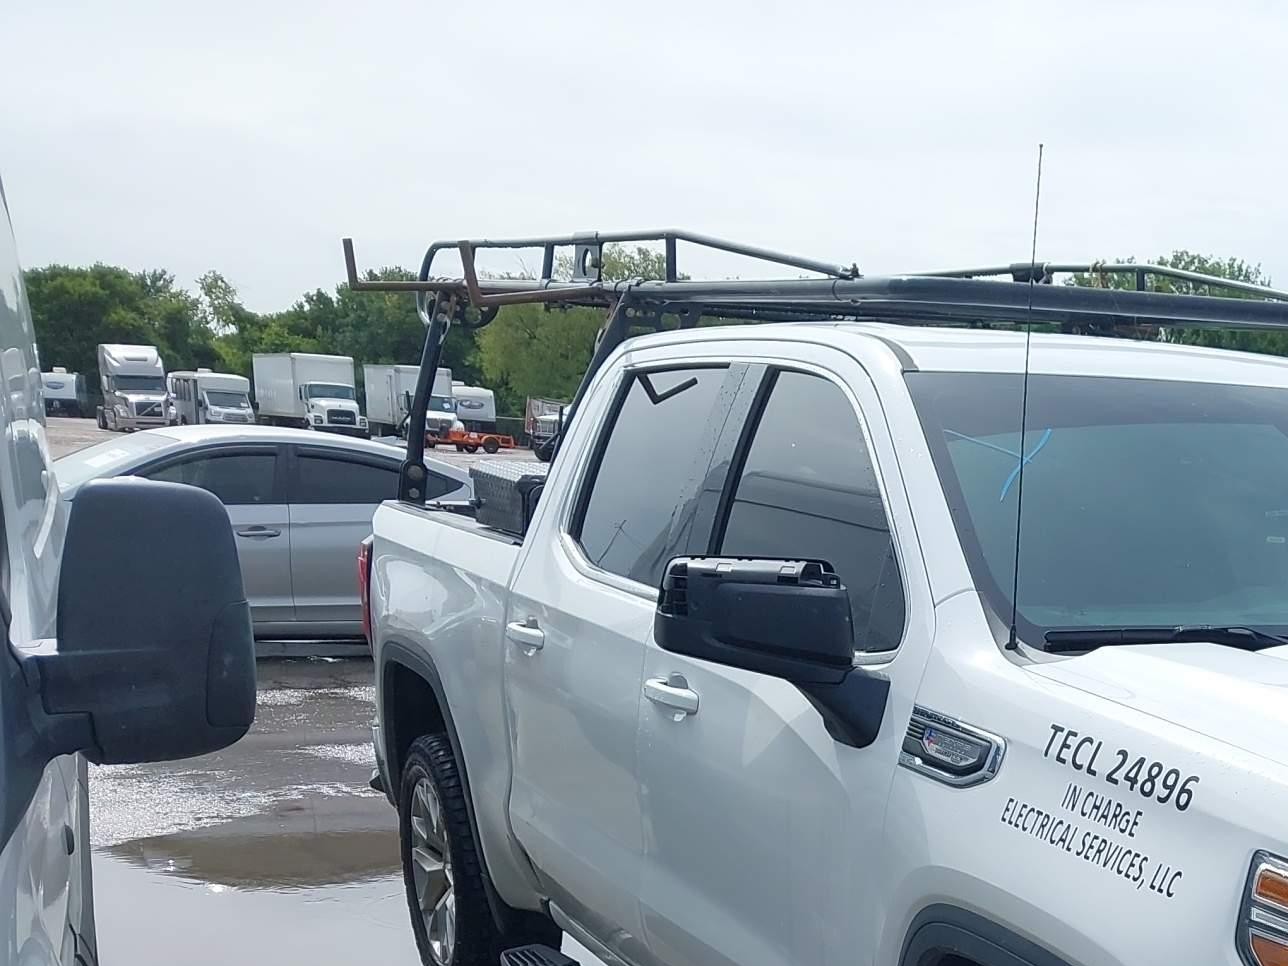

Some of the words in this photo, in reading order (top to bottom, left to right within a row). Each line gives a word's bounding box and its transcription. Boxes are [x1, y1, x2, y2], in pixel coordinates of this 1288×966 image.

[1043, 723, 1103, 777] TECL
[1105, 749, 1200, 812] 24896
[1061, 783, 1082, 811] IN
[1080, 791, 1143, 838] CHARGE
[1001, 798, 1078, 852] ELECTRICAL
[1075, 831, 1148, 890] SERVICES,
[1149, 863, 1183, 898] LLC
